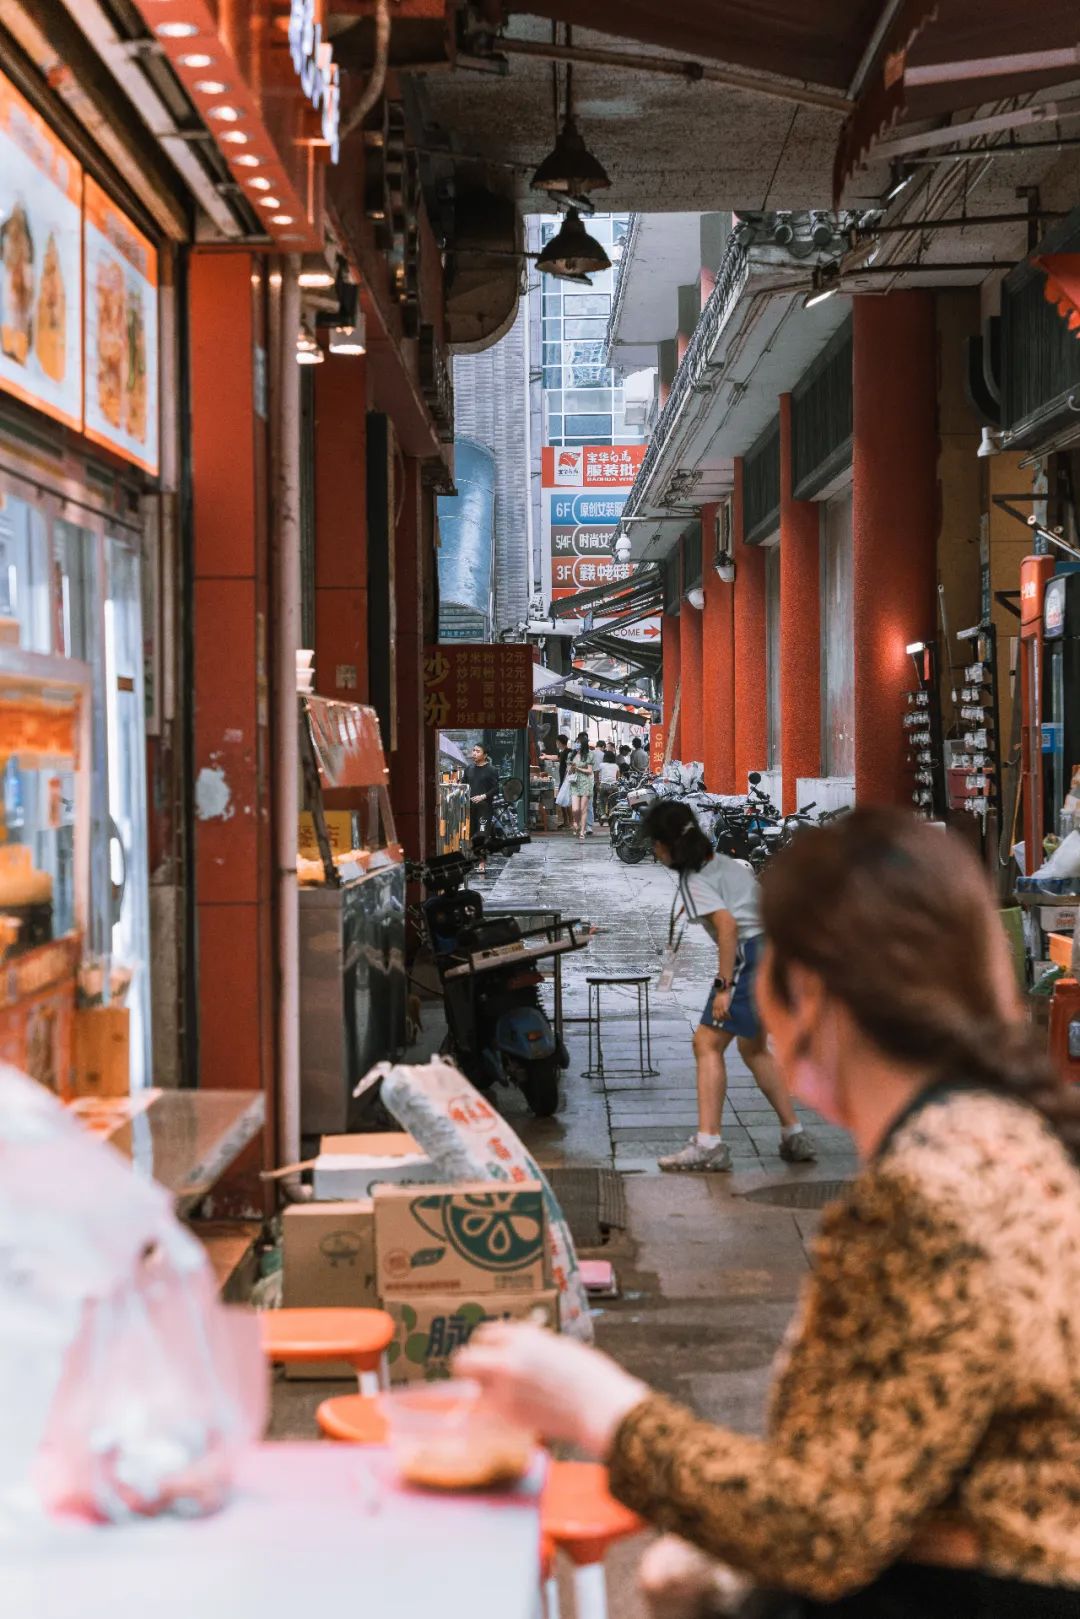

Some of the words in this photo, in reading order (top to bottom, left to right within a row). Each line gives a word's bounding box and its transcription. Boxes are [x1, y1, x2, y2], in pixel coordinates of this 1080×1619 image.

[556, 502, 571, 517] 6F
[555, 535, 571, 550] 5/4F
[556, 565, 571, 580] 3F
[613, 628, 641, 637] COME
[500, 651, 527, 664] 12元
[500, 666, 527, 680] 12元
[500, 681, 527, 694] 12元
[500, 697, 527, 709] 12元
[500, 712, 527, 724] 12元
